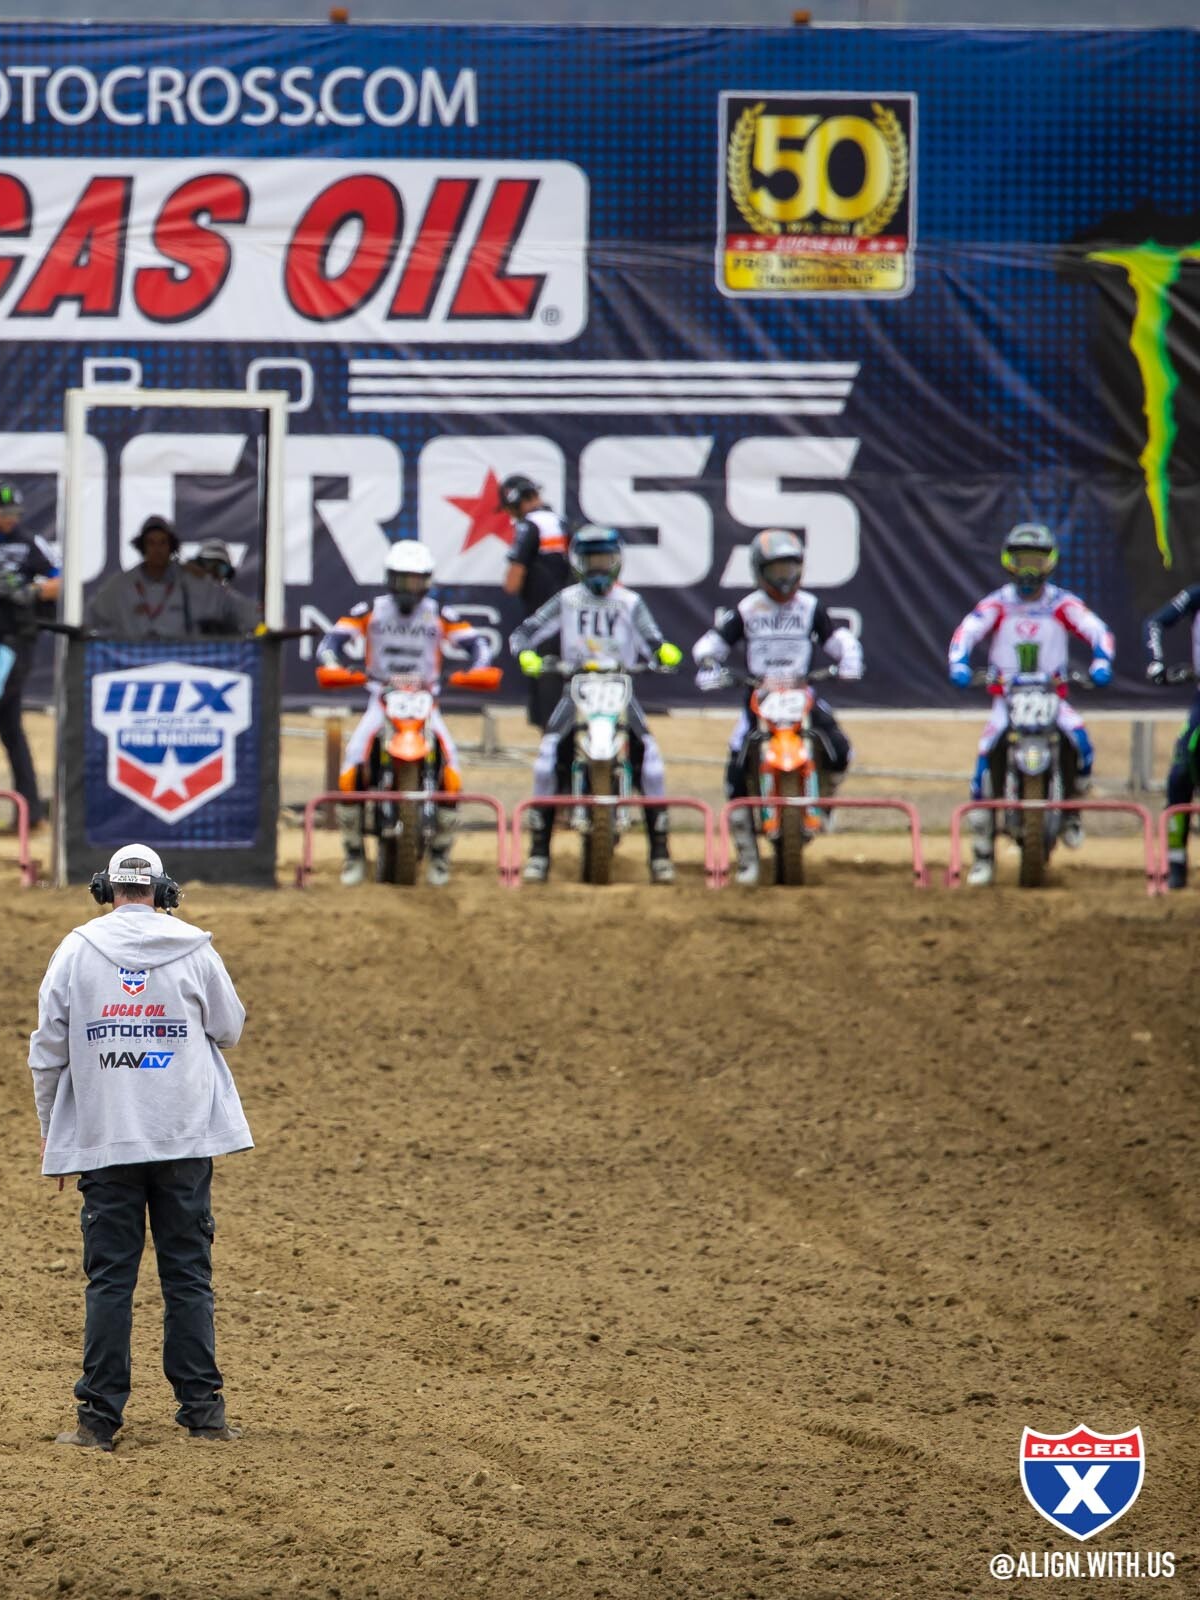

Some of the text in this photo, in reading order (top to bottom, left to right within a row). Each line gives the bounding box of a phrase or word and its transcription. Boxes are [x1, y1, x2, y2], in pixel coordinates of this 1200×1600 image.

[749, 114, 892, 223] 50
[282, 173, 547, 323] OIL
[579, 610, 619, 636] FLY
[104, 680, 240, 713] MX
[101, 1003, 166, 1017] LUCAS OIL
[86, 1024, 188, 1041] MOTOCROSS
[99, 1051, 175, 1069] MAVTV
